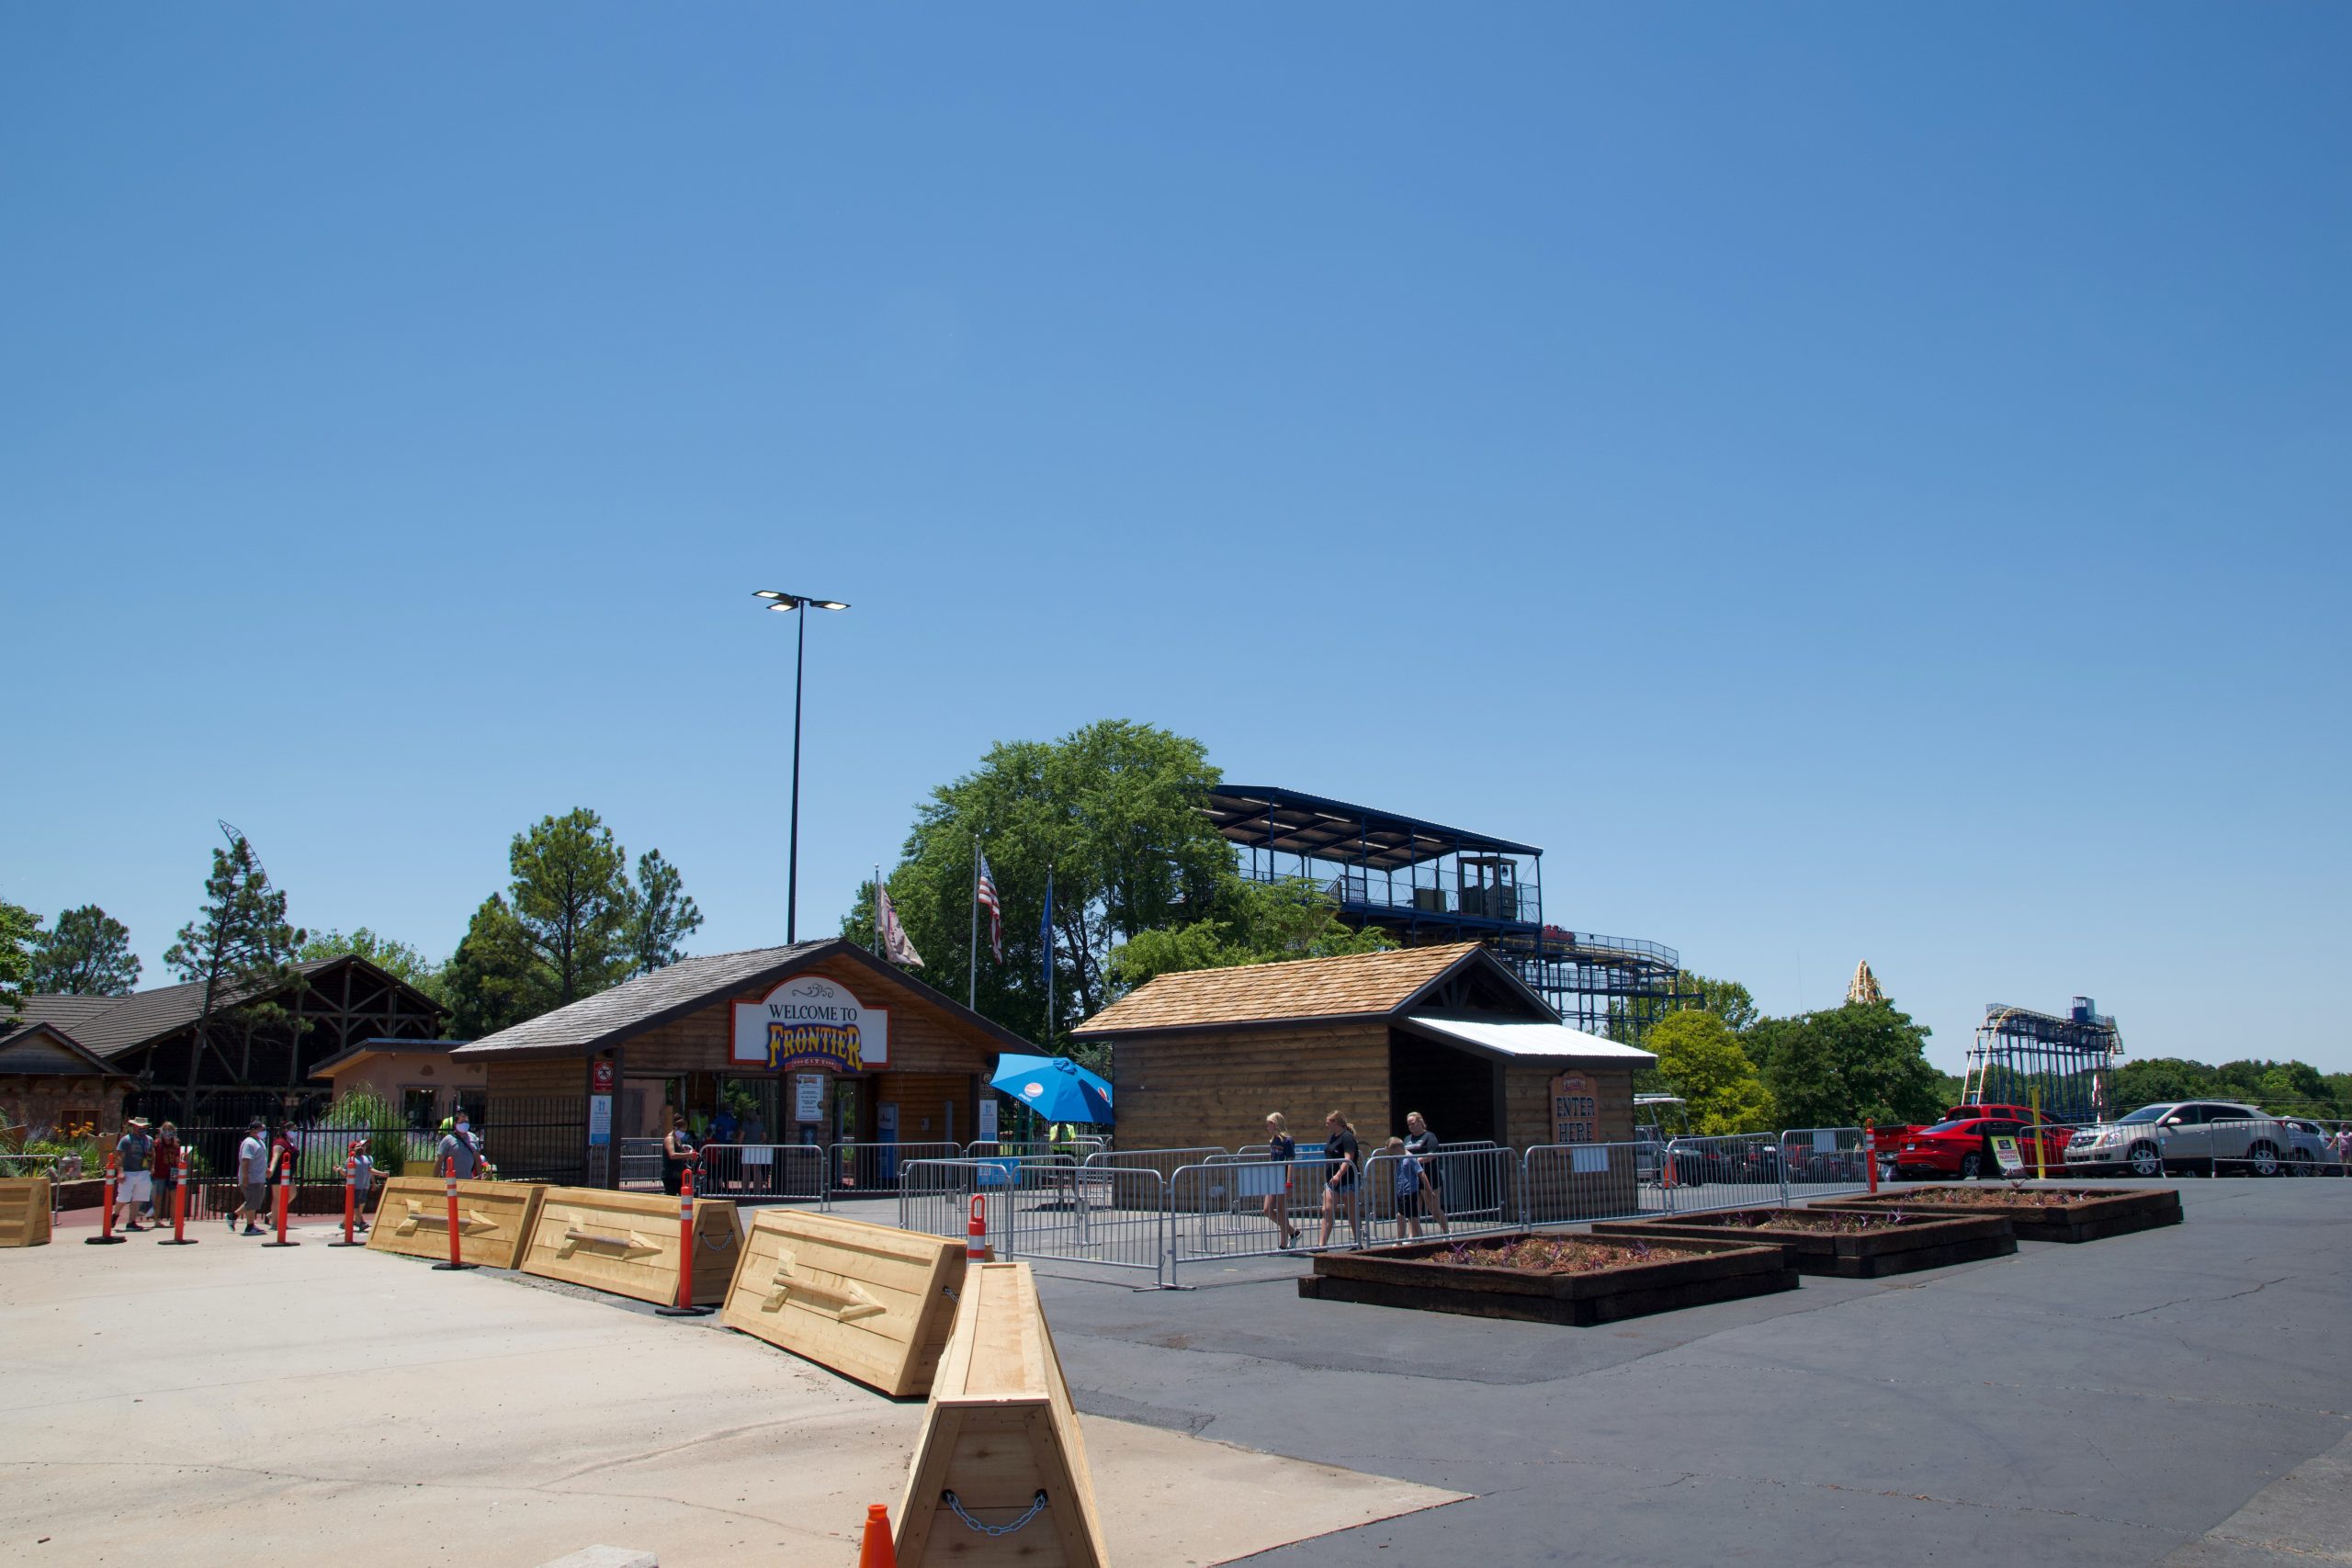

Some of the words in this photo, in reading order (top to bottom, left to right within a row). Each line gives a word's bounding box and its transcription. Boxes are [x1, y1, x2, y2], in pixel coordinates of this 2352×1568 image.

[769, 1004, 838, 1021] WELCOME
[841, 1007, 858, 1021] TO
[769, 1024, 863, 1072] FRONTIER
[1556, 1097, 1595, 1118] ENTER
[1558, 1122, 1593, 1143] HERE
